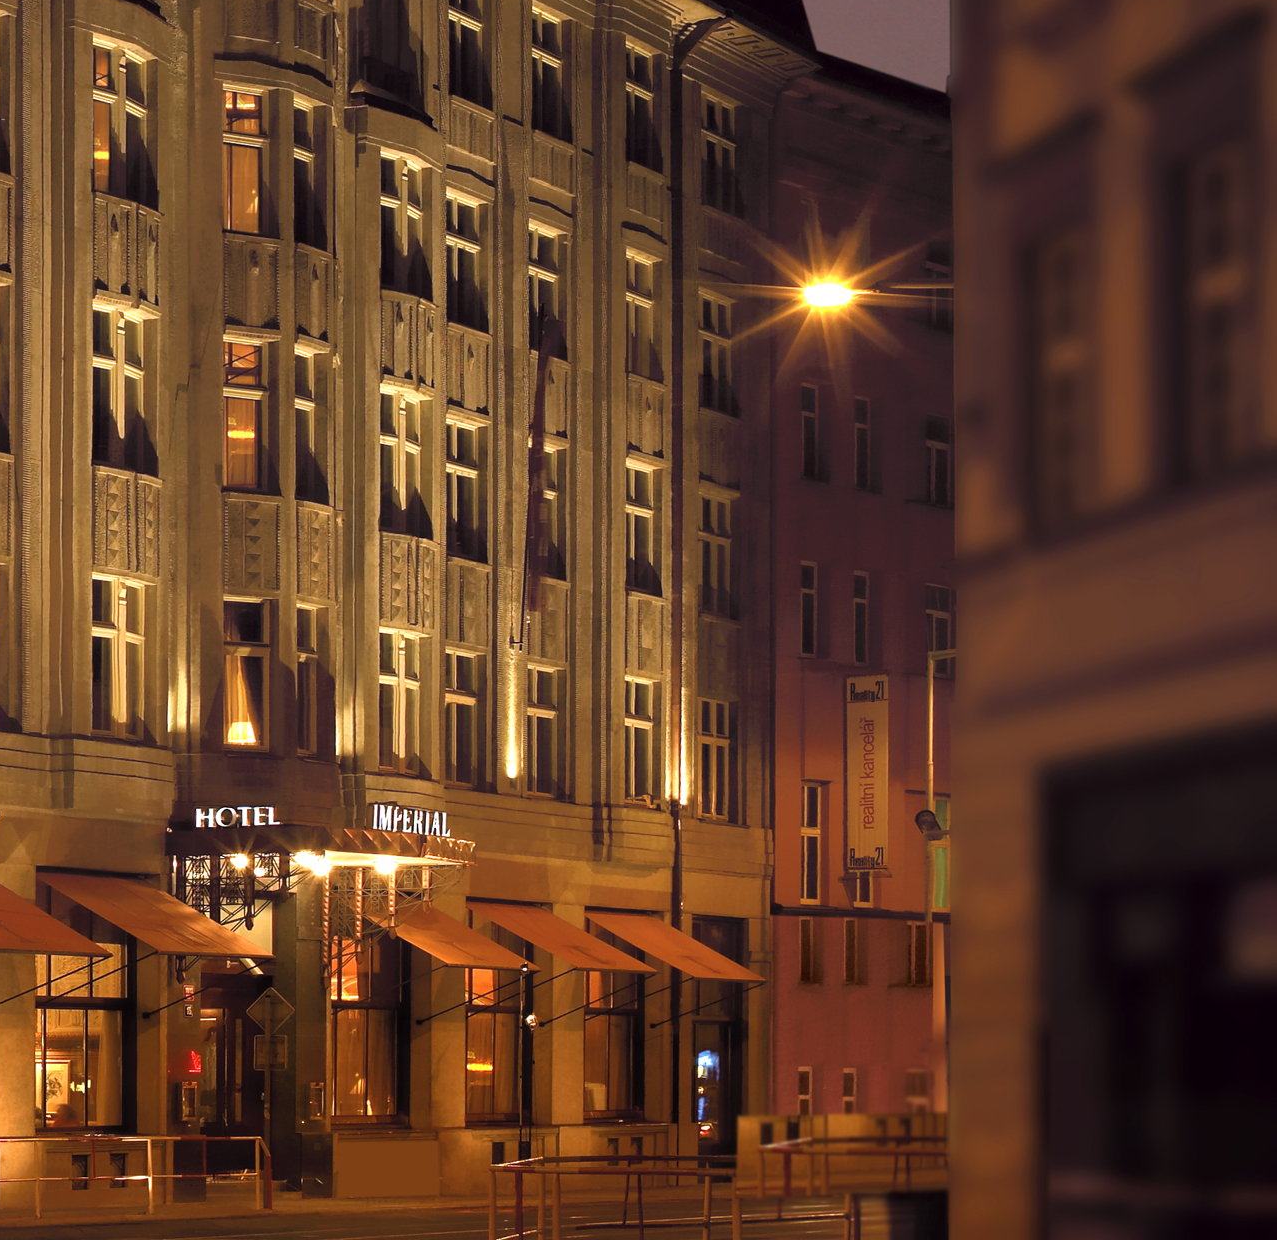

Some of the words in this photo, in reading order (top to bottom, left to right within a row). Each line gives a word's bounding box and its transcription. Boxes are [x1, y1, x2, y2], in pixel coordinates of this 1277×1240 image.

[859, 717, 875, 779] kancelář
[195, 806, 280, 828] HOTEL
[373, 803, 451, 837] IMPERIAL
[859, 782, 875, 829] realitní
